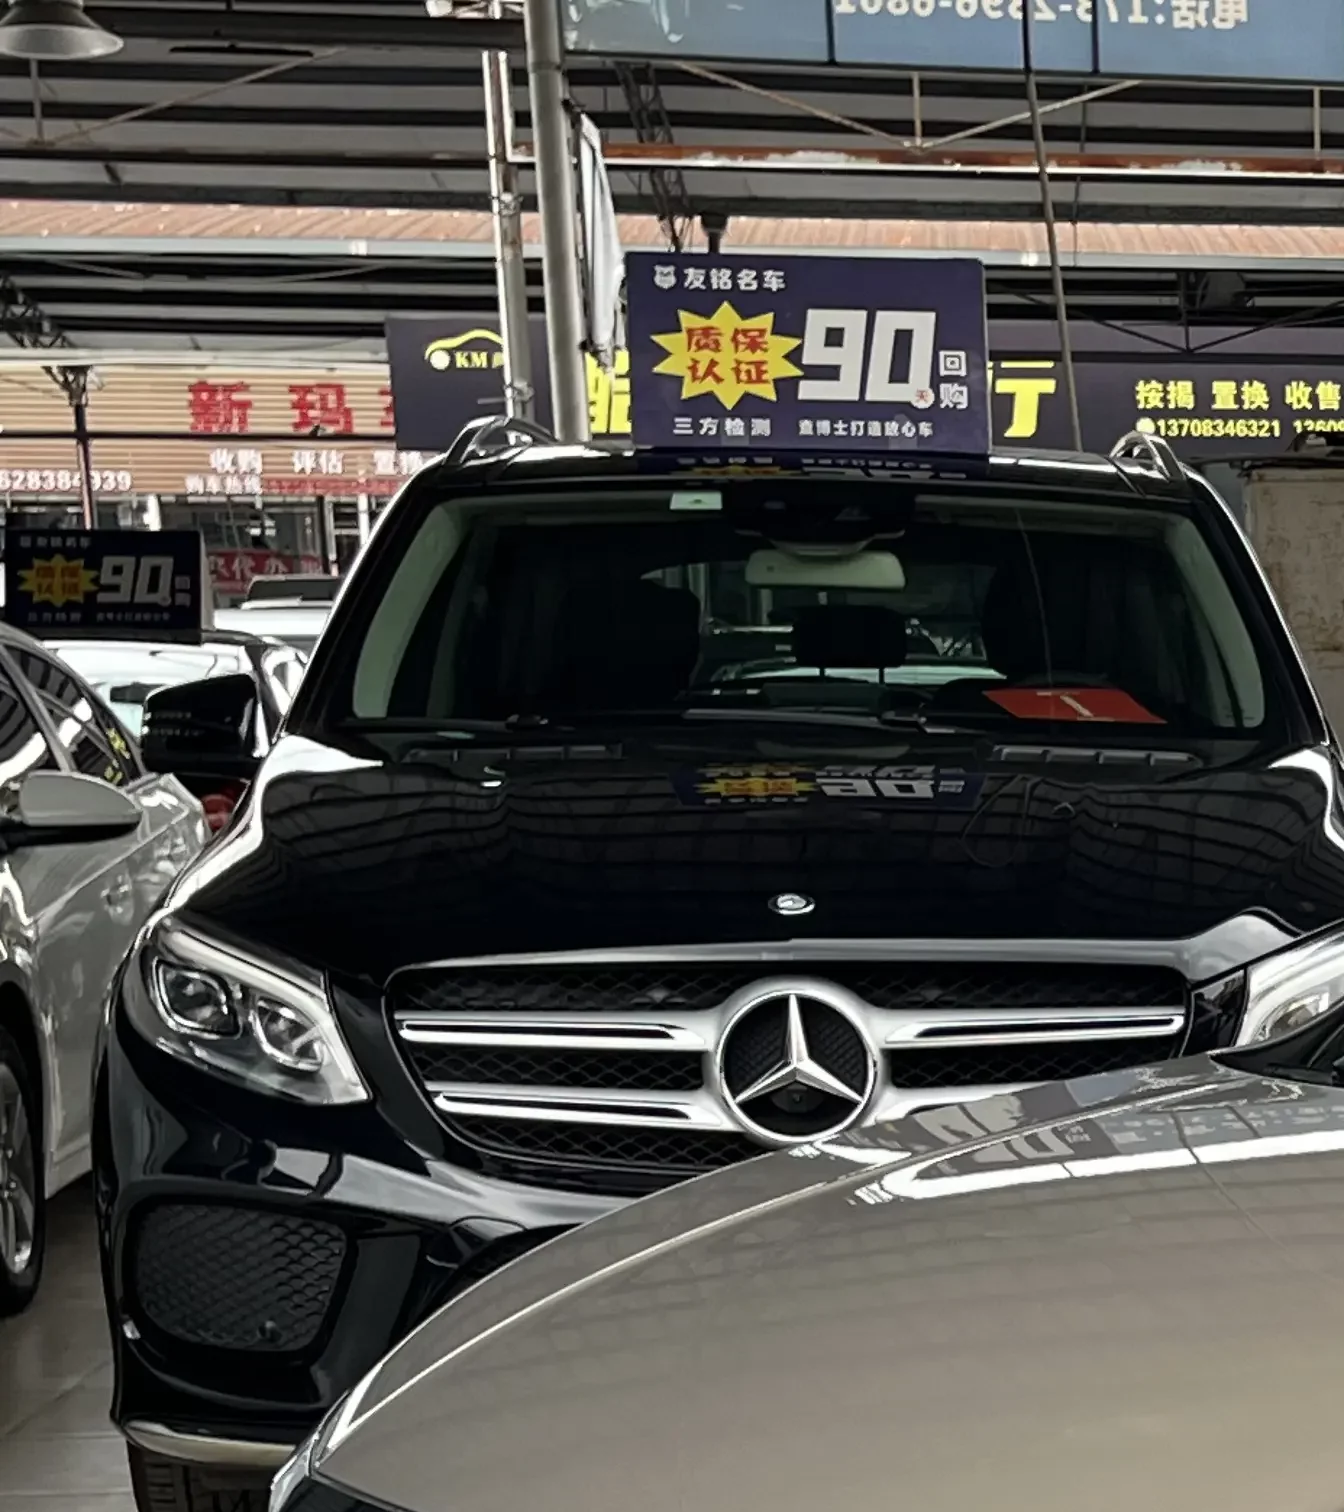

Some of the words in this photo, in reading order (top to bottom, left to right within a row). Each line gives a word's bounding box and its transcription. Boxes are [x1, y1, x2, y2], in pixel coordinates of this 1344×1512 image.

[684, 268, 785, 292] 友铭名车
[686, 326, 769, 354] 质保
[798, 309, 936, 402] 90
[687, 357, 770, 385] 认证
[1135, 379, 1195, 410] 按揭
[1211, 380, 1270, 410] 置换
[1285, 380, 1342, 410] 收售
[1157, 418, 1281, 438] 13708346321
[97, 556, 173, 604] 90
